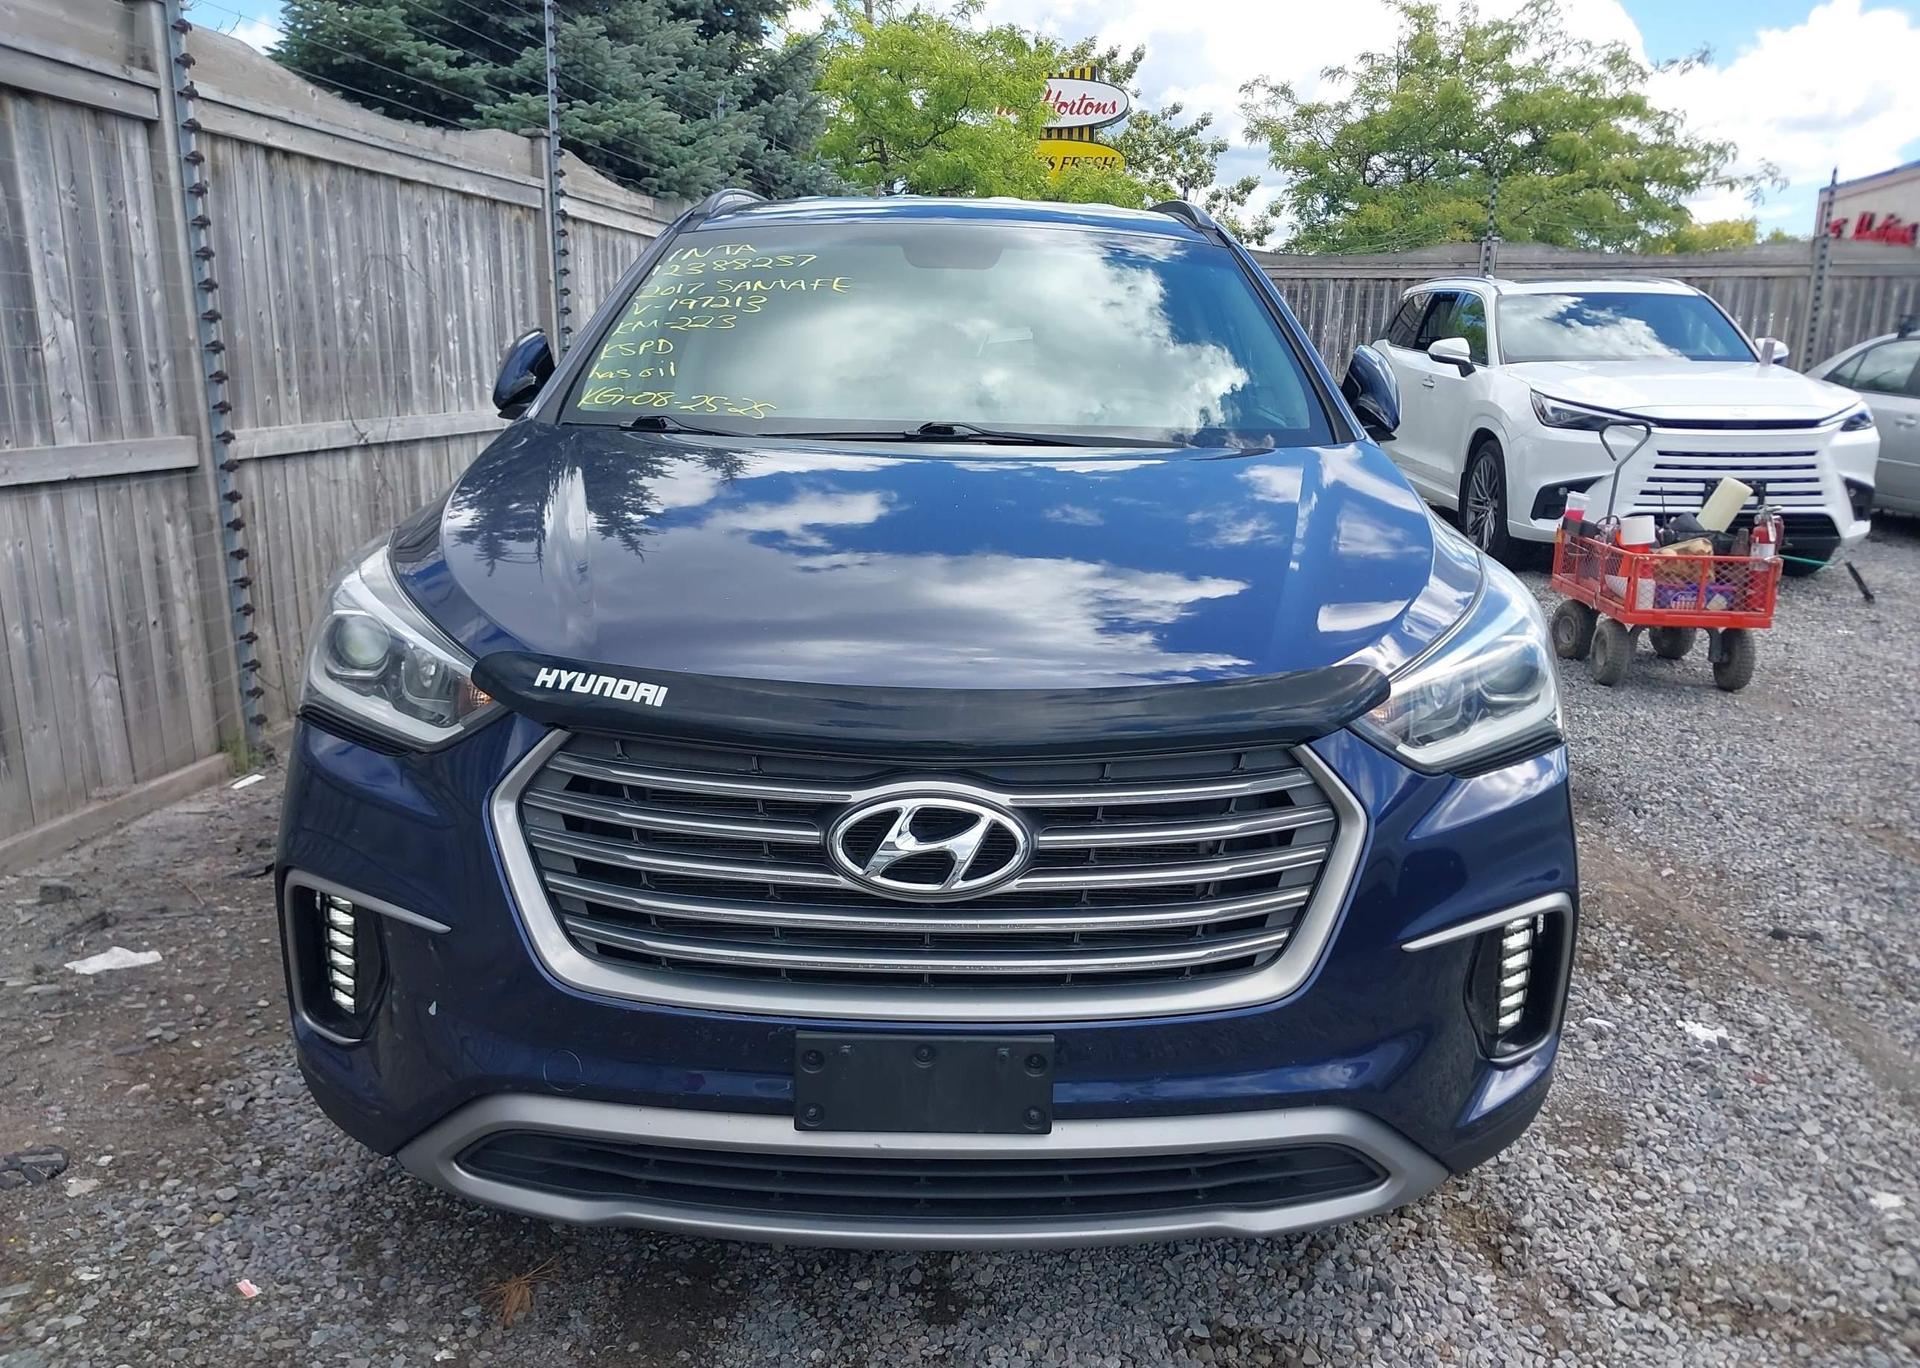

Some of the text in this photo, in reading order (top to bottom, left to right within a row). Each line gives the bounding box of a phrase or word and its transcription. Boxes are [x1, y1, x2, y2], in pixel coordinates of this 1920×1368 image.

[1044, 89, 1117, 115] Hortons
[639, 360, 675, 377] oil
[533, 667, 669, 707] HYUNDAI
